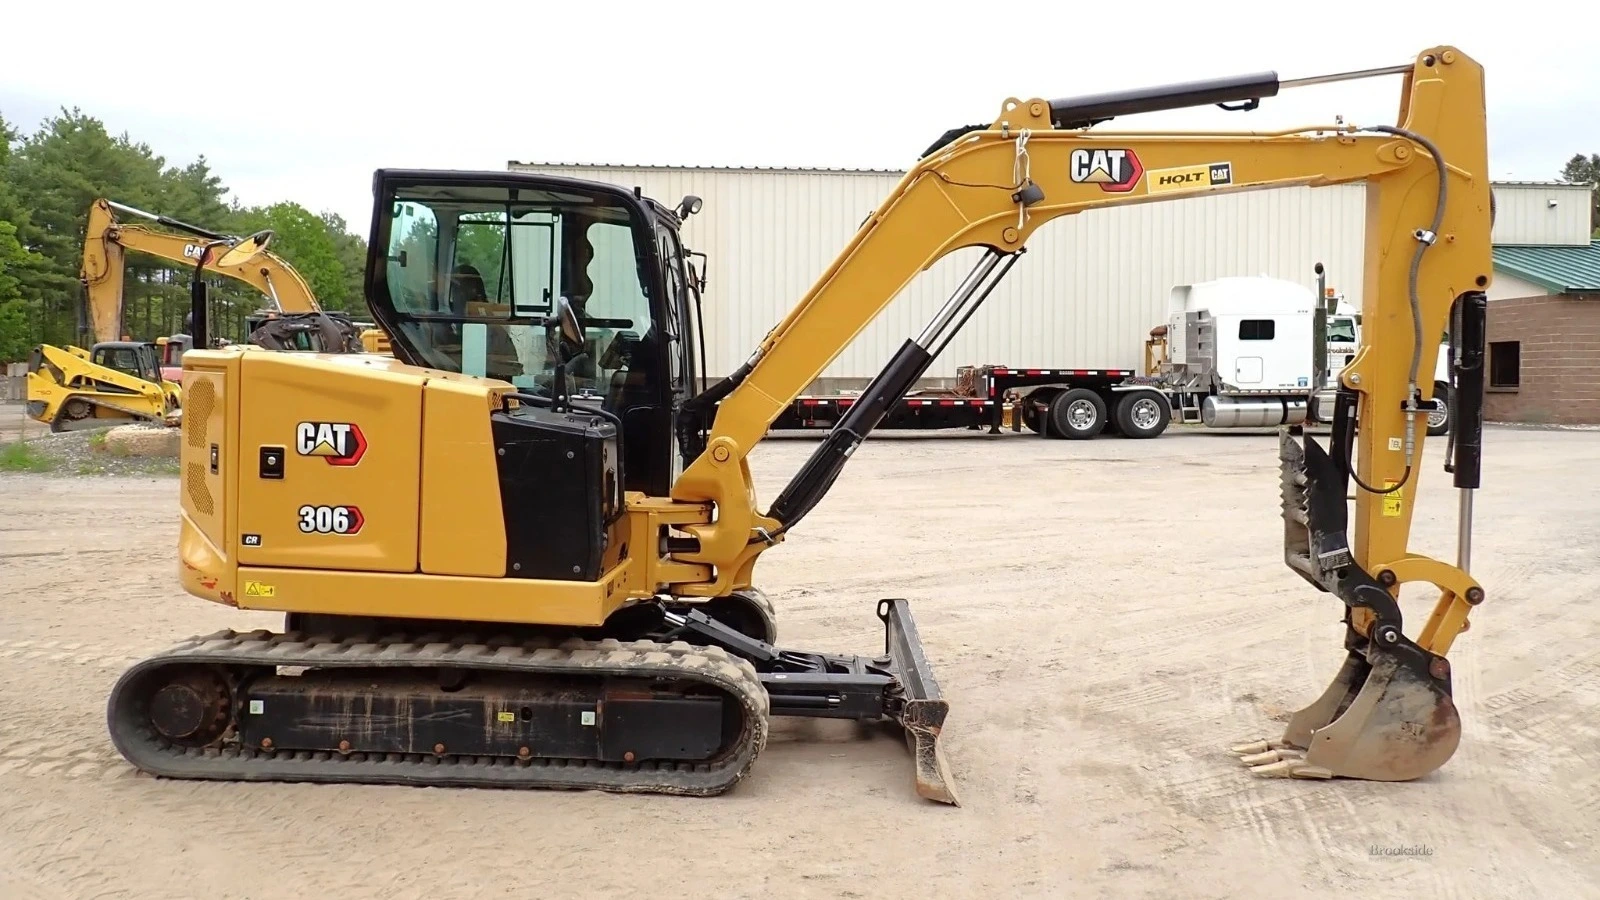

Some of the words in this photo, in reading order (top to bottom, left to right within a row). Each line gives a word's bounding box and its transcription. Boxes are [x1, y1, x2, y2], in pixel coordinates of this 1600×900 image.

[1071, 149, 1125, 183] CAT
[1159, 171, 1204, 186] HOLT
[1210, 168, 1228, 181] CAT
[297, 422, 351, 456] CAT
[299, 506, 349, 534] 306
[245, 536, 258, 545] CR
